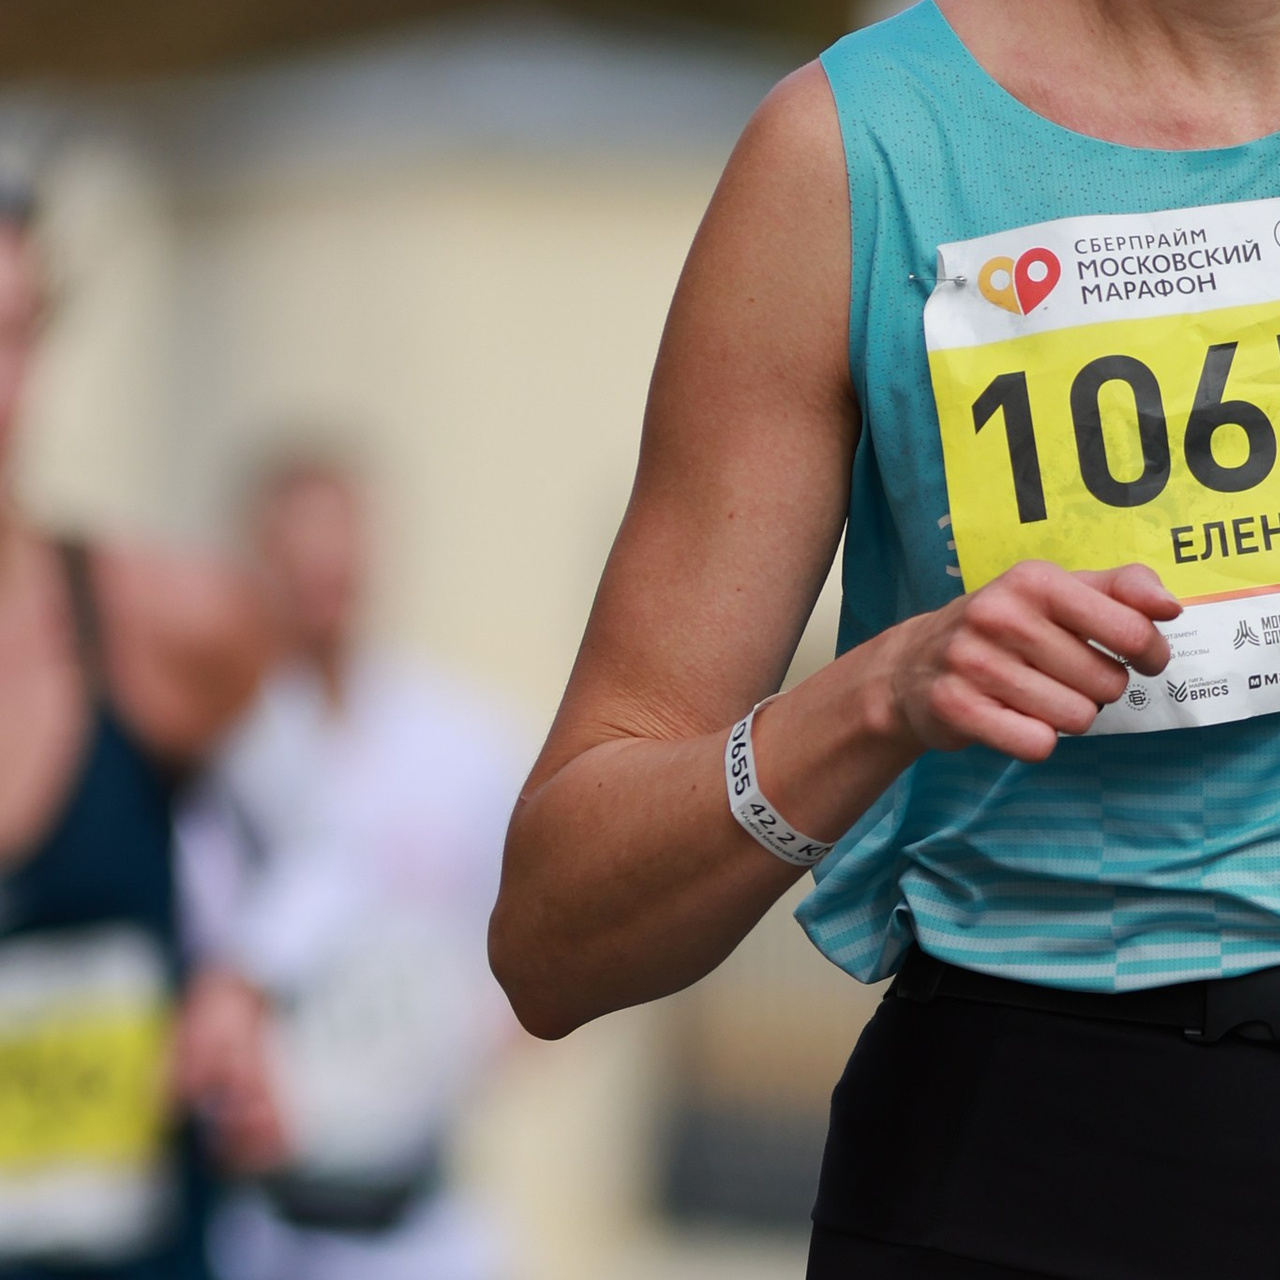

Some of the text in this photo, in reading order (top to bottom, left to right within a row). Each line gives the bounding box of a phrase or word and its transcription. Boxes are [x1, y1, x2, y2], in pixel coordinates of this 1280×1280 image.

[1074, 227, 1208, 255] СБЕРПРАЙМ
[1076, 238, 1262, 281] МОСКОВСКИЙ
[1080, 272, 1217, 305] МАРАФОН
[1189, 684, 1229, 701] BRICS
[731, 721, 751, 796] 0655
[749, 802, 796, 846] 42,2
